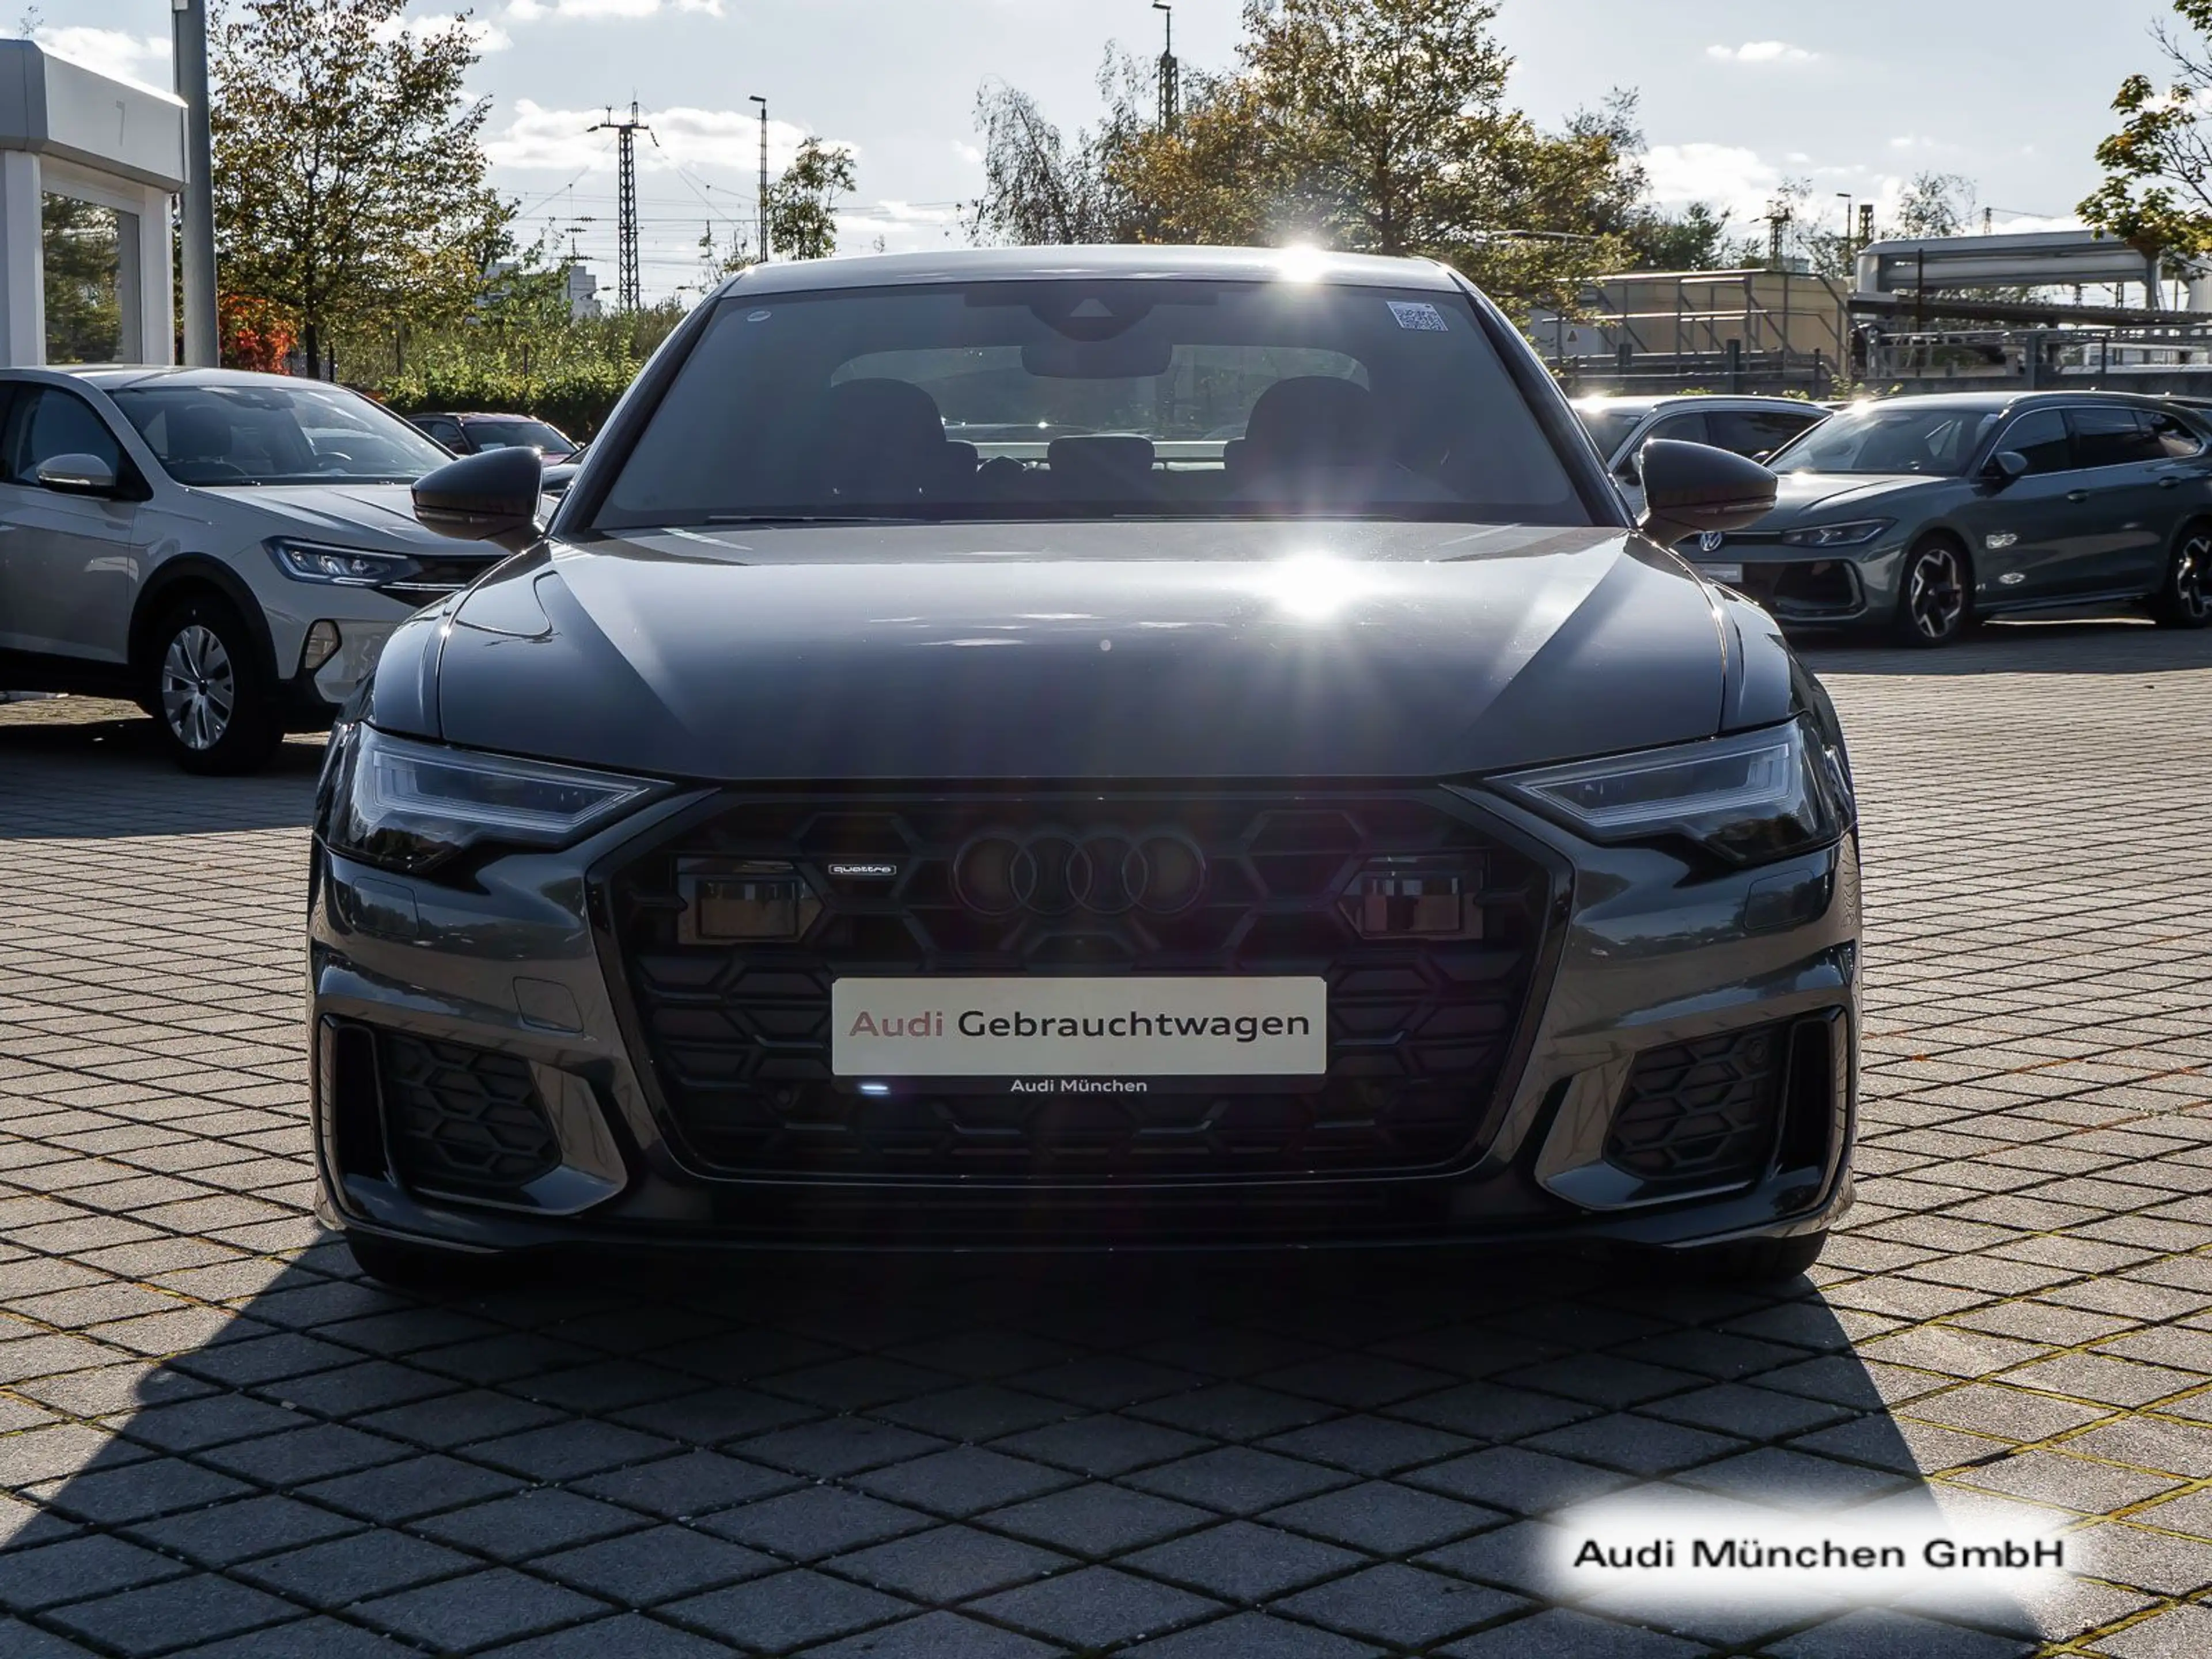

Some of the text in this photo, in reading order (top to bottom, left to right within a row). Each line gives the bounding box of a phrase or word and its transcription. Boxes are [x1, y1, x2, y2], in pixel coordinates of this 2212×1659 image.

[834, 866, 892, 874] quattro
[849, 1010, 1310, 1043] Audi Gebrauchtwagen
[1010, 1078, 1147, 1092] Audi München
